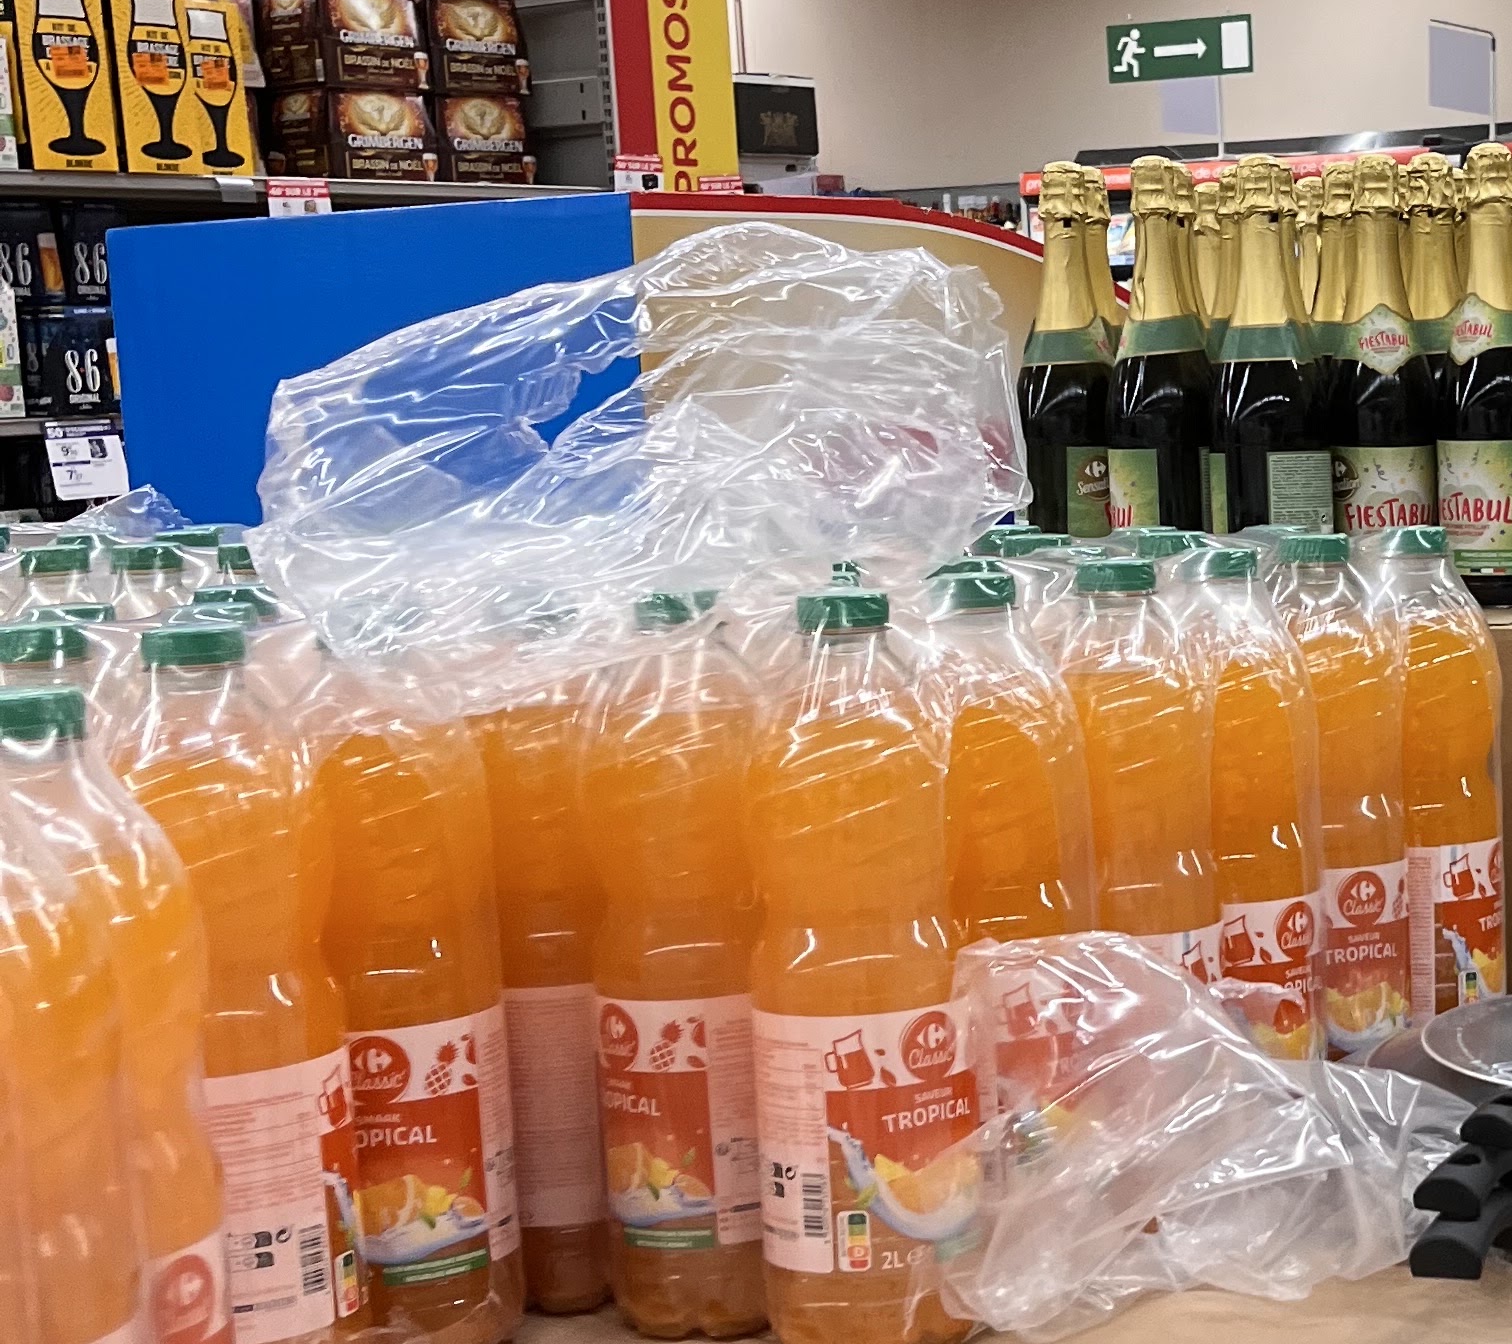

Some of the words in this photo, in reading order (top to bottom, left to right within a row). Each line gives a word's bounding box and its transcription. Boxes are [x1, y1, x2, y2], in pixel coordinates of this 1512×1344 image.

[1344, 498, 1438, 531] FIESTABU
[1324, 943, 1399, 965] TROPICAL
[909, 1042, 955, 1069] Classic
[604, 1091, 661, 1117] OPICAL
[881, 1097, 970, 1133] TROPICAL
[354, 1125, 437, 1148] OPICAL
[881, 1251, 904, 1269] 2L
